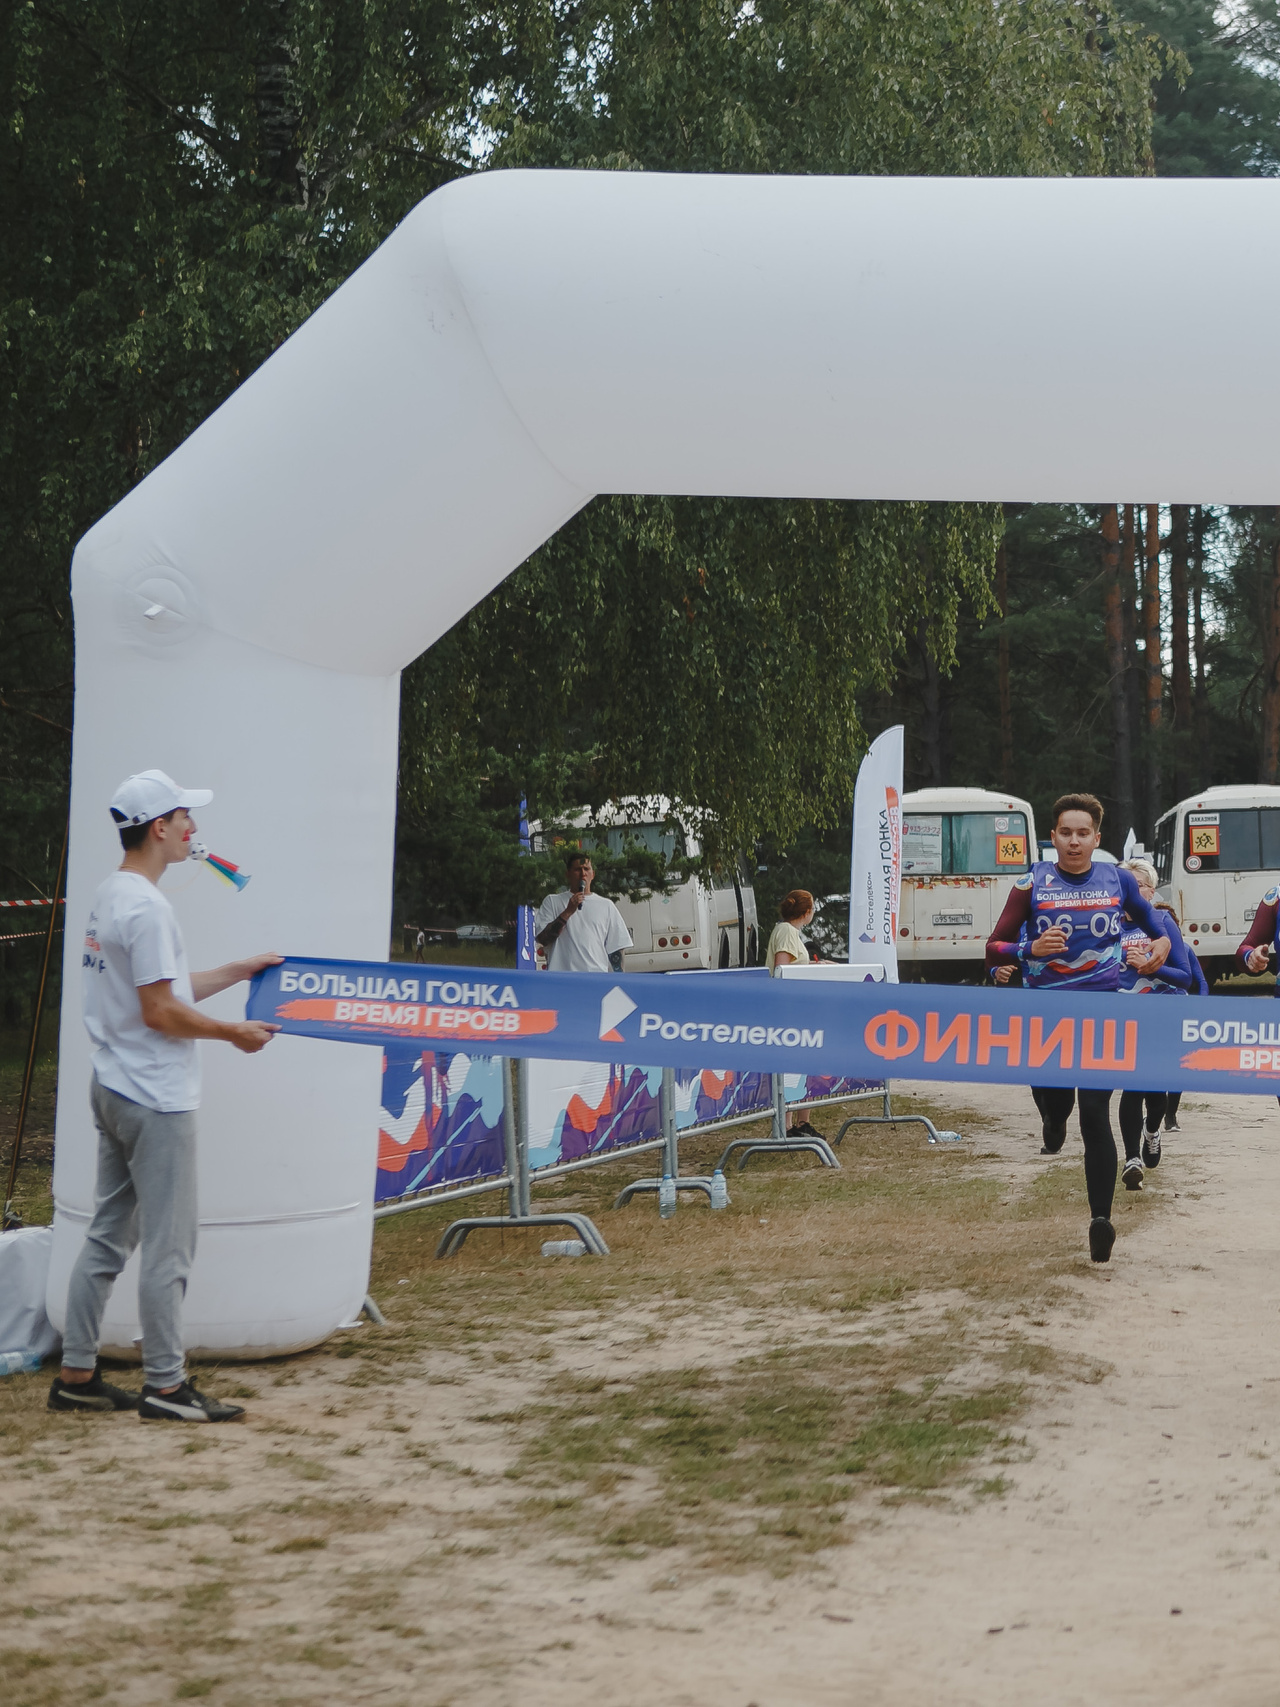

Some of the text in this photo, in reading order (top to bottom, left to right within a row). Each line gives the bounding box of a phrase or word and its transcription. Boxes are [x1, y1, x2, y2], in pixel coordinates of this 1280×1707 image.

[879, 809, 892, 944] БОЛЬШАЯ ГОНКА
[1189, 859, 1198, 867] 60
[866, 871, 874, 931] Ростелеком
[1036, 890, 1110, 901] БОЛЬШАЯ ГОНКА
[279, 970, 519, 1008] БОЛЬШАЯ ГОНКА
[334, 1001, 520, 1032] ВРЕМЯ ГЕРОЕВ
[639, 1013, 825, 1048] Ростелеком
[863, 1010, 1138, 1071] ФИНИШ
